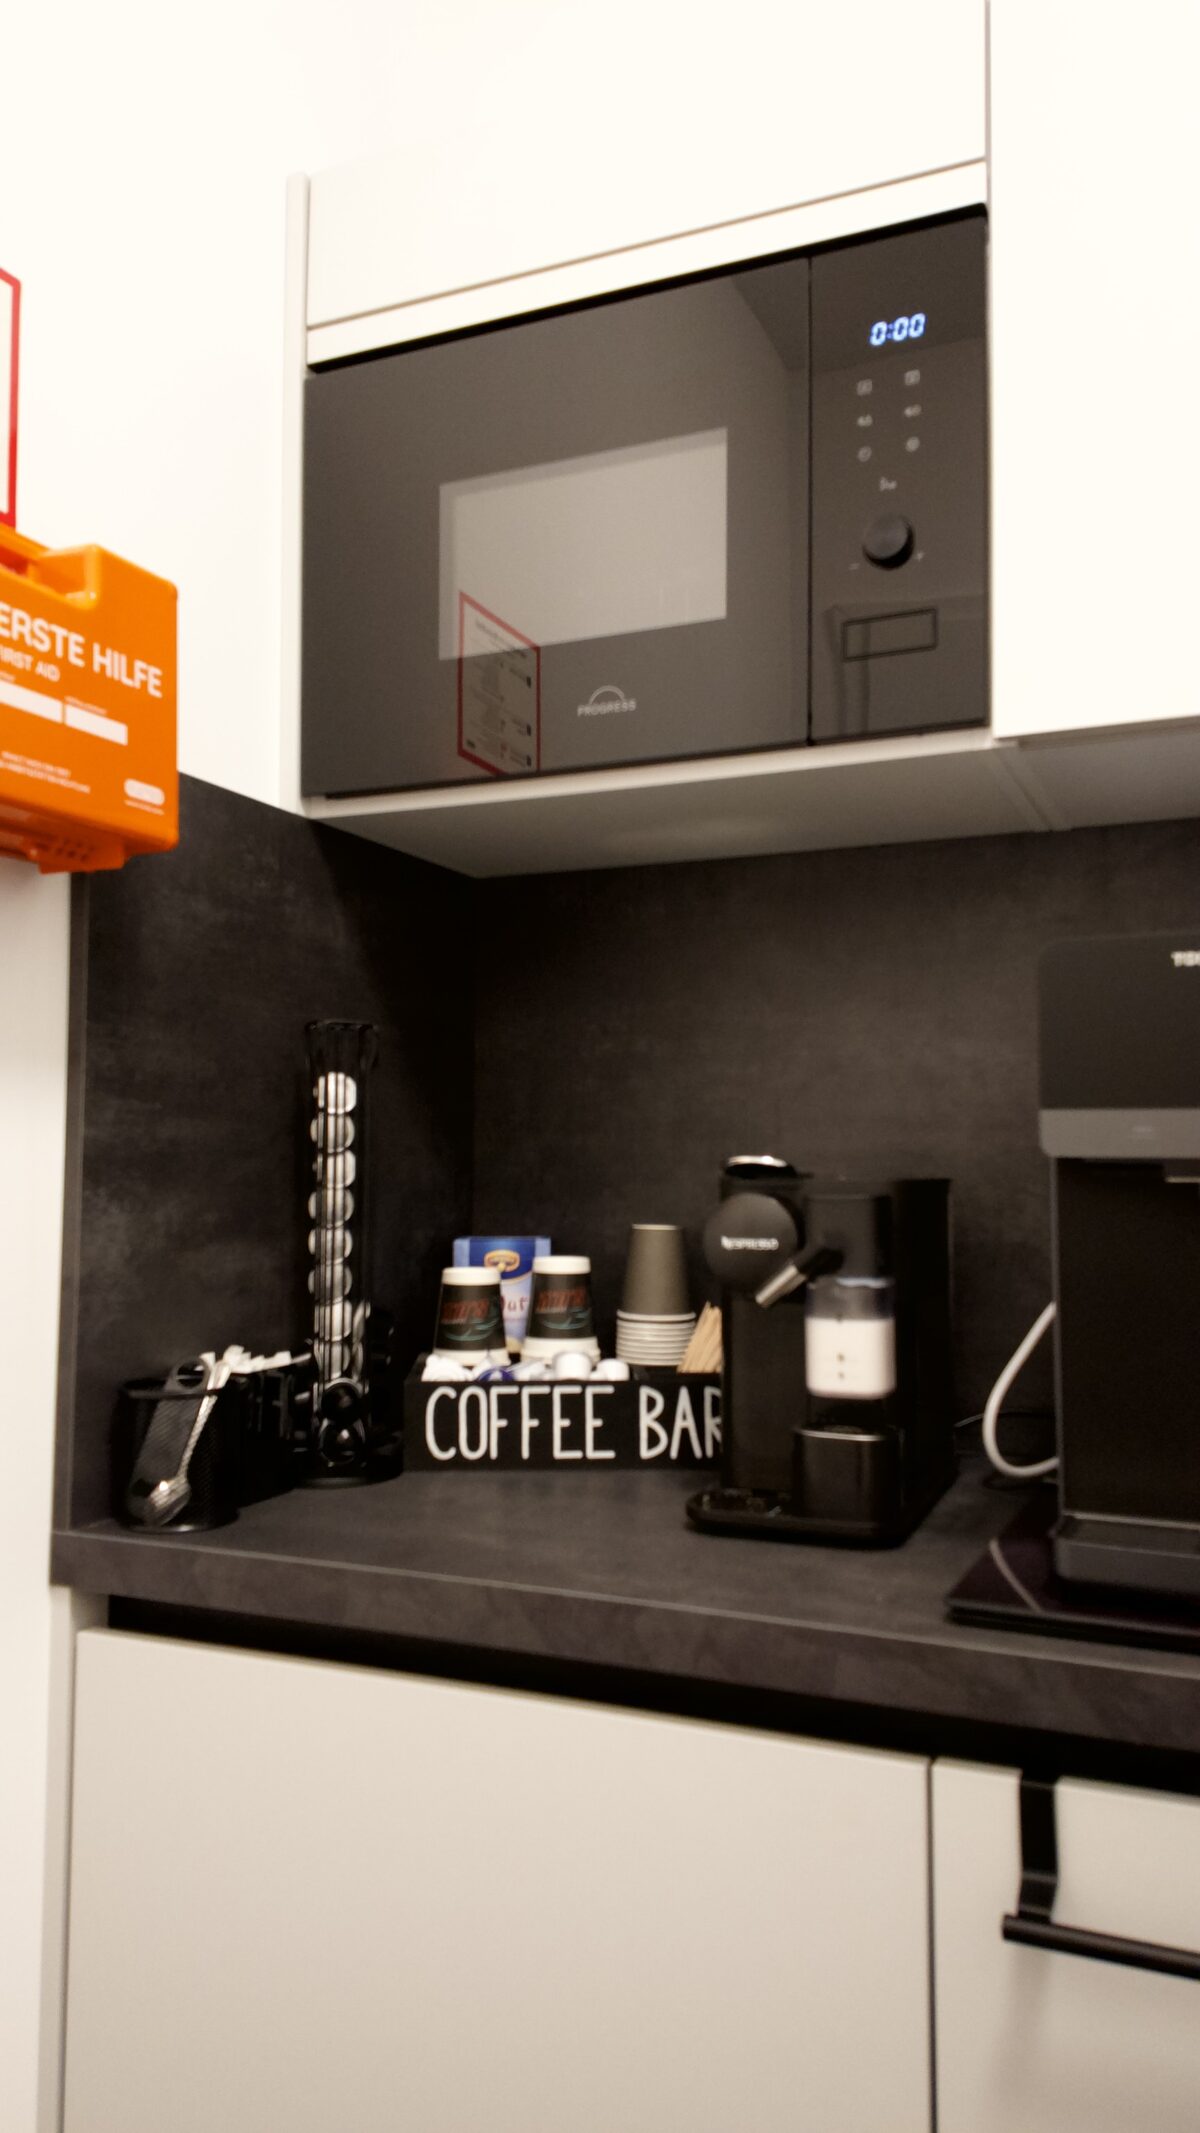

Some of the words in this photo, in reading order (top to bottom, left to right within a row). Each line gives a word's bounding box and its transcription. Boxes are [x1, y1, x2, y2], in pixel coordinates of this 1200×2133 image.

[869, 312, 926, 346] 0:00
[34, 659, 61, 683] AID
[93, 642, 163, 698] HILFE
[577, 698, 637, 717] PROGRESS
[424, 1385, 615, 1461] COFFEE
[638, 1385, 722, 1461] BAR
